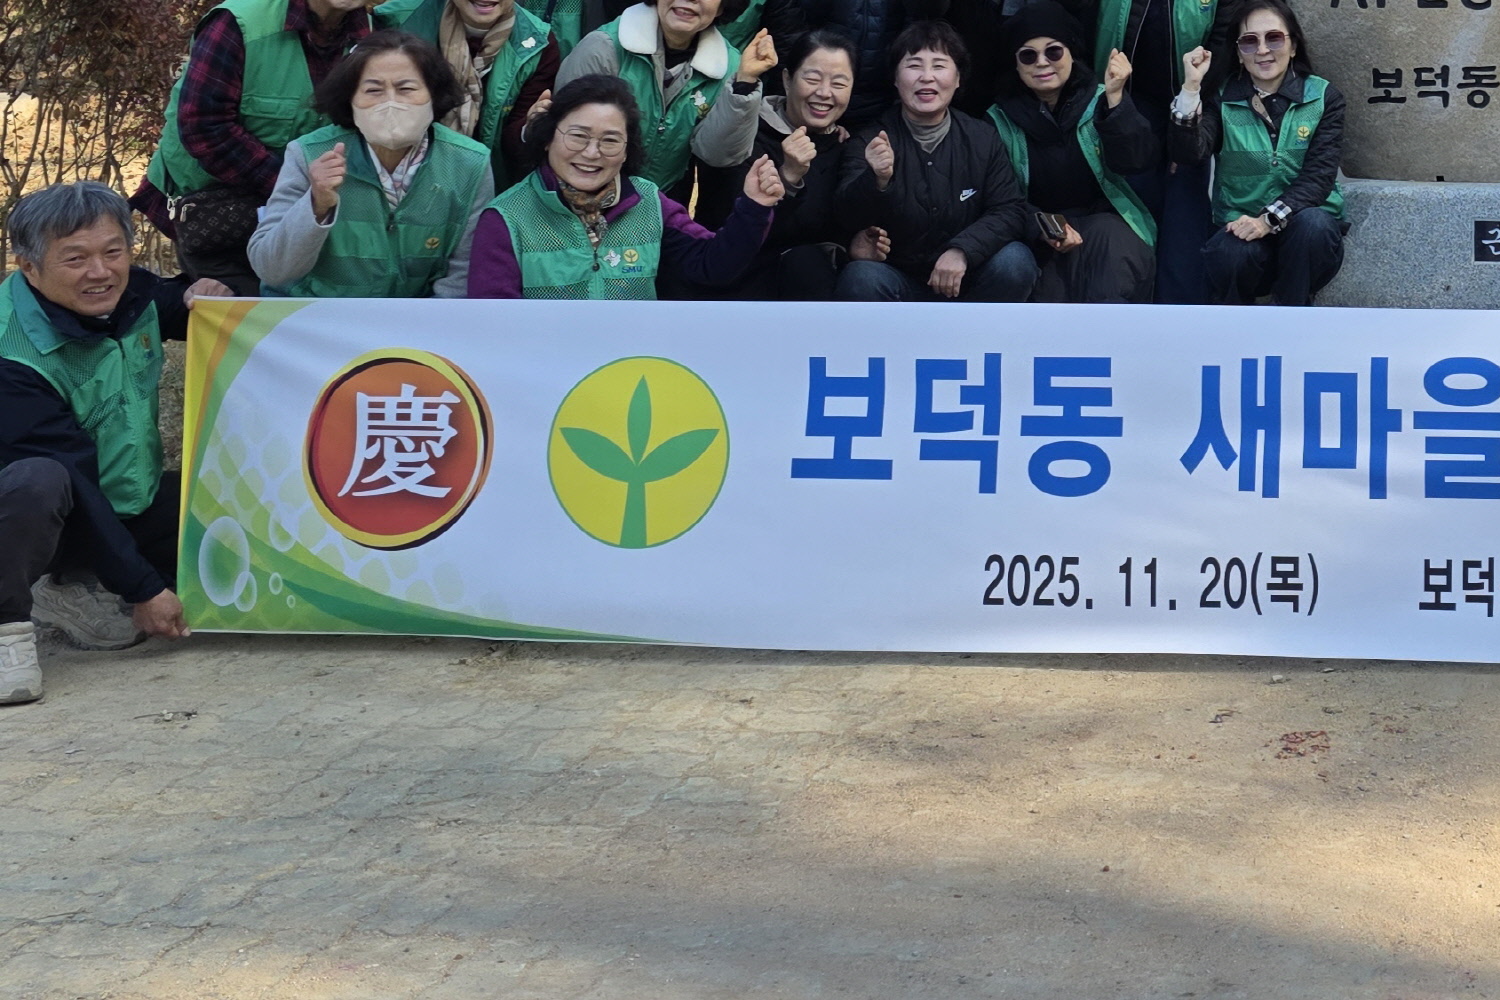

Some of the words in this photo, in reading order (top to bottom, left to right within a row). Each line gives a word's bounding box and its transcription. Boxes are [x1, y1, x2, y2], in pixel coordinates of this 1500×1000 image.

[1367, 65, 1500, 109] 보덕동
[338, 384, 462, 499] 慶
[791, 353, 1124, 498] 보덕동
[982, 554, 1093, 610] 2025.
[1118, 556, 1177, 611] 11.
[1199, 551, 1320, 617] 20(목)
